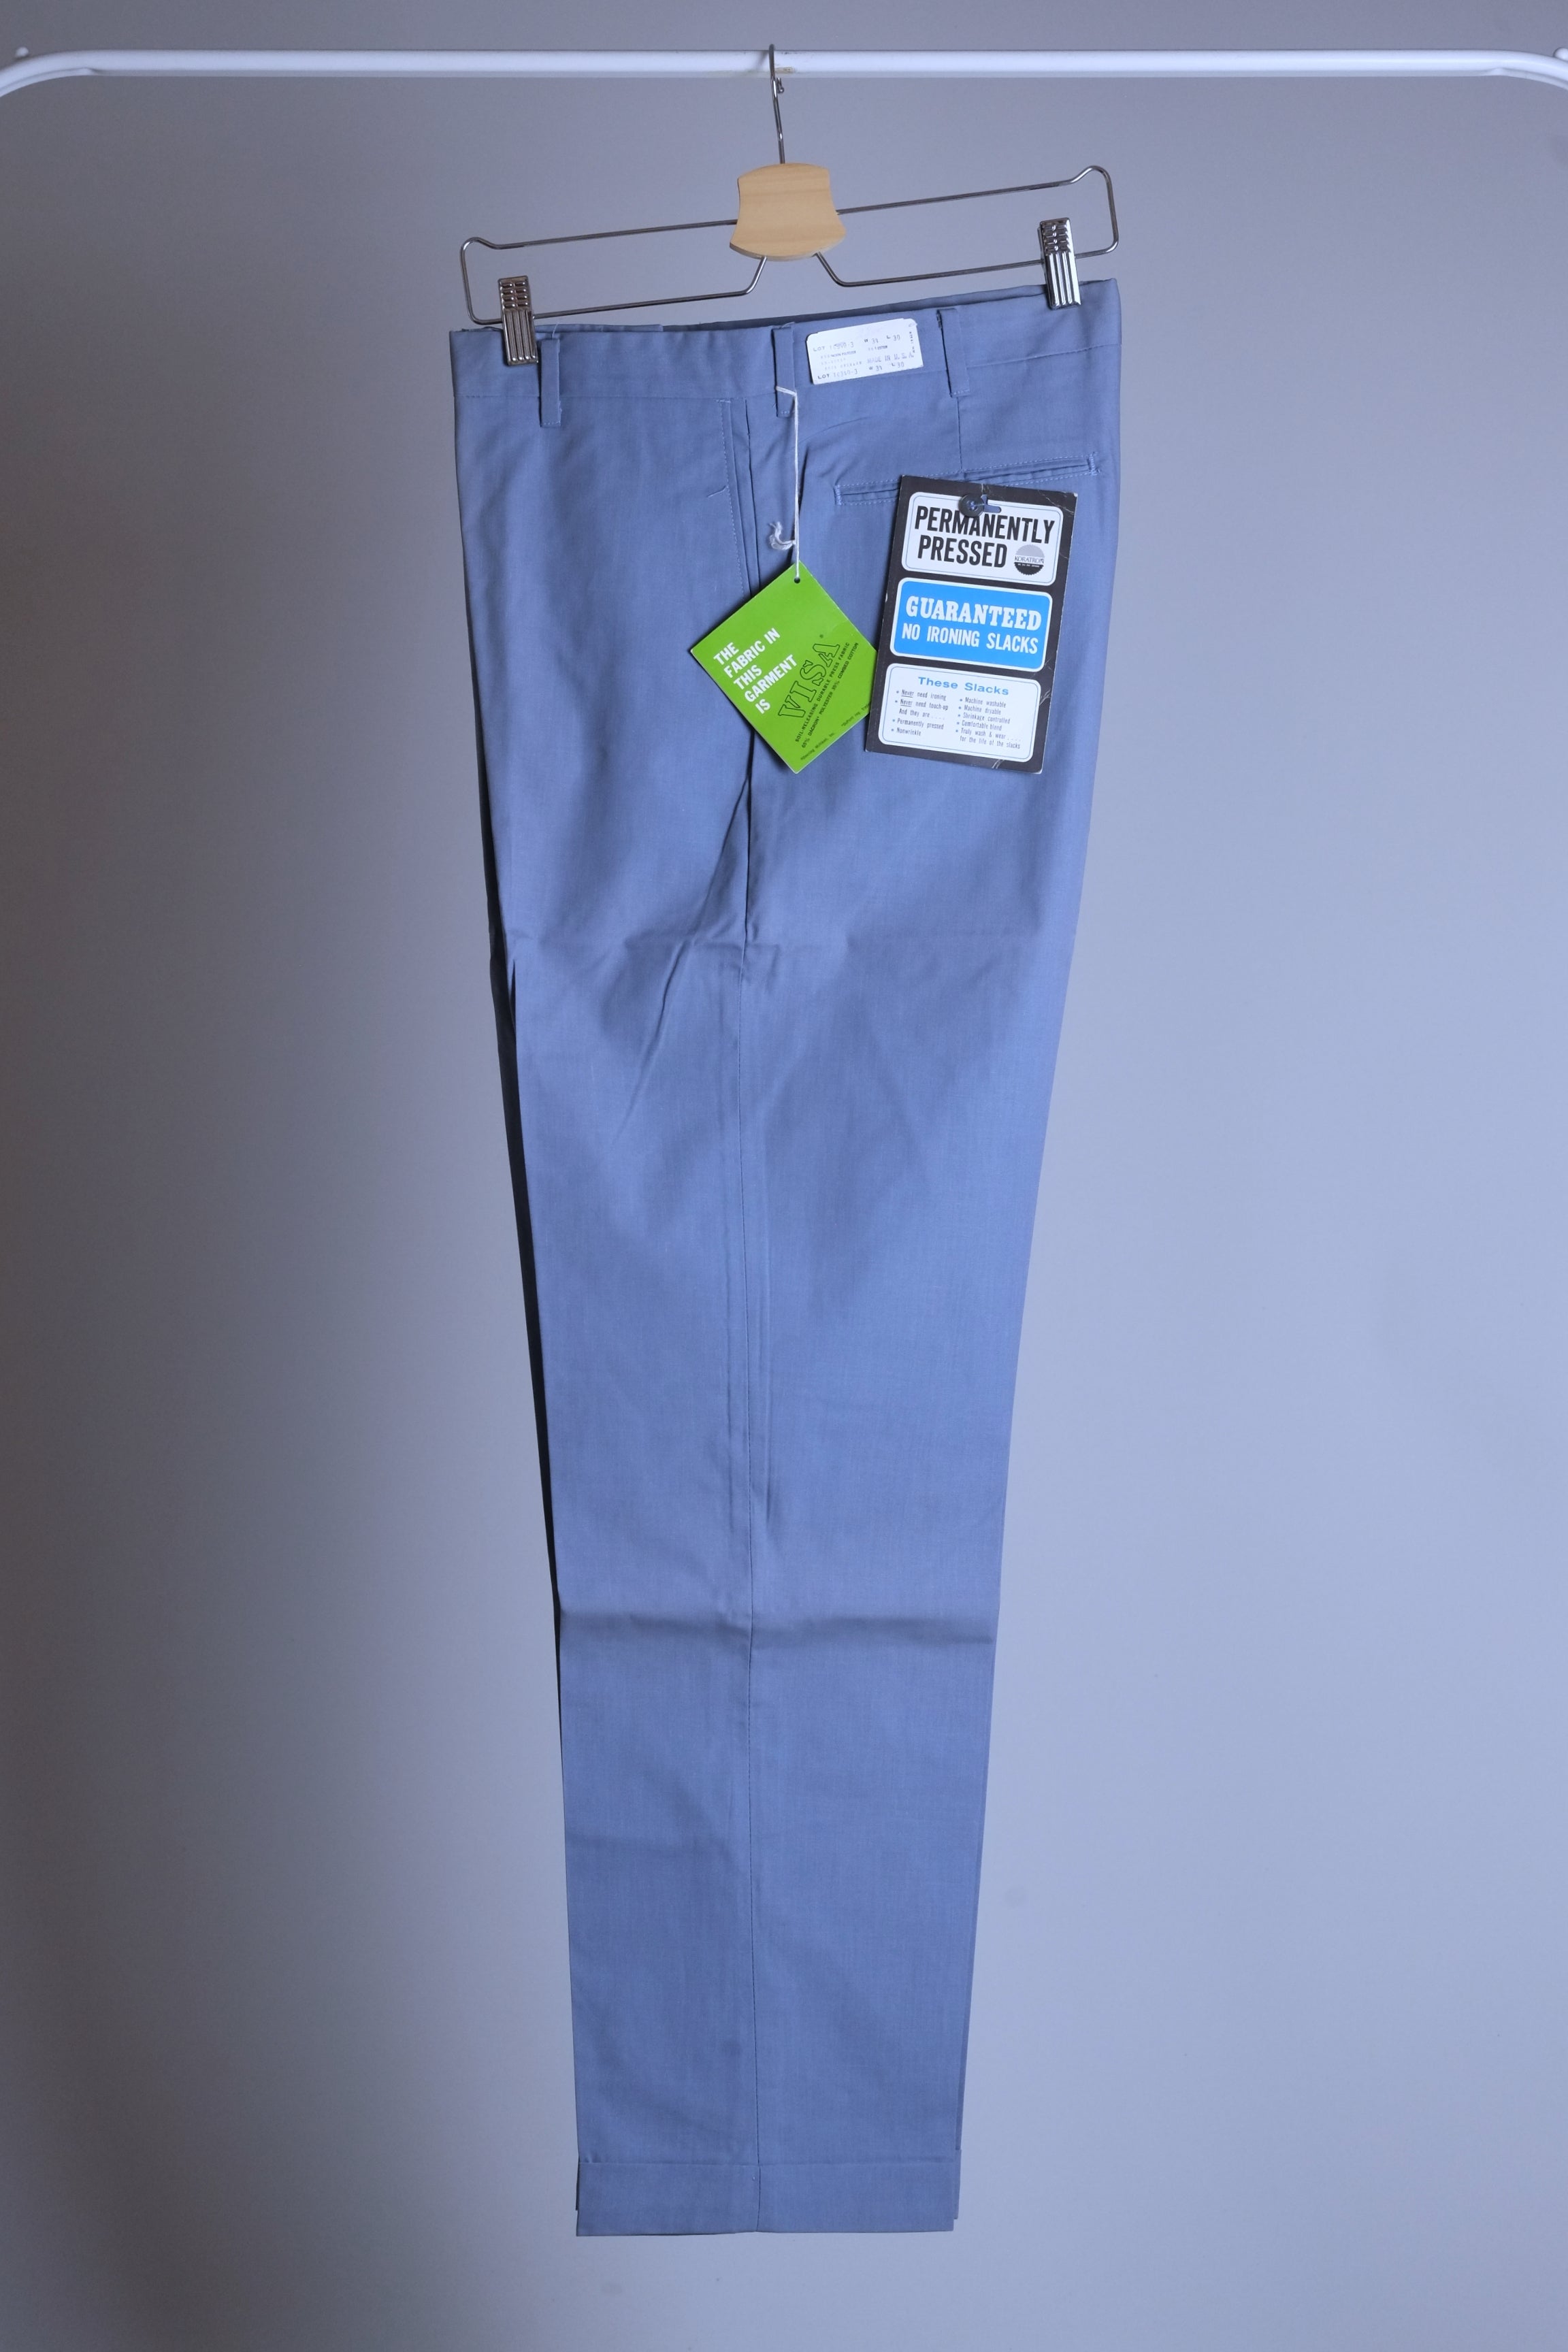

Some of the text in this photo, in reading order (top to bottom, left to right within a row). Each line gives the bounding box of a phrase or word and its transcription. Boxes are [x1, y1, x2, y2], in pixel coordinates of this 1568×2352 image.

[915, 506, 1055, 544] PERMANENTLY
[917, 534, 1008, 568] PRESSED
[906, 595, 1042, 631] GUARANTEED
[902, 623, 1039, 654] NO IRONING SLACKS
[713, 642, 739, 665] THE
[723, 627, 781, 678] FABRIC IN
[733, 664, 762, 689] THIS
[745, 654, 797, 702] GARMENT
[778, 643, 840, 718] VISA
[819, 691, 834, 715] POLYESTER
[838, 661, 849, 679] COMBED
[849, 642, 858, 660] COTTON
[918, 676, 1009, 695] These Slacks
[795, 642, 850, 742] SOIL-RELEASING DURABLE PRESS FABRIC
[901, 689, 914, 697] Never
[930, 693, 947, 701] ironing
[965, 696, 983, 705] Machine
[755, 698, 770, 714] IS
[929, 702, 949, 711] touch-up
[964, 704, 981, 713] Machine
[897, 718, 924, 728] Permanently
[962, 719, 988, 729] Comfortable
[963, 712, 1011, 724] Shrinkage controlled
[896, 727, 921, 736] Nonwrinkle
